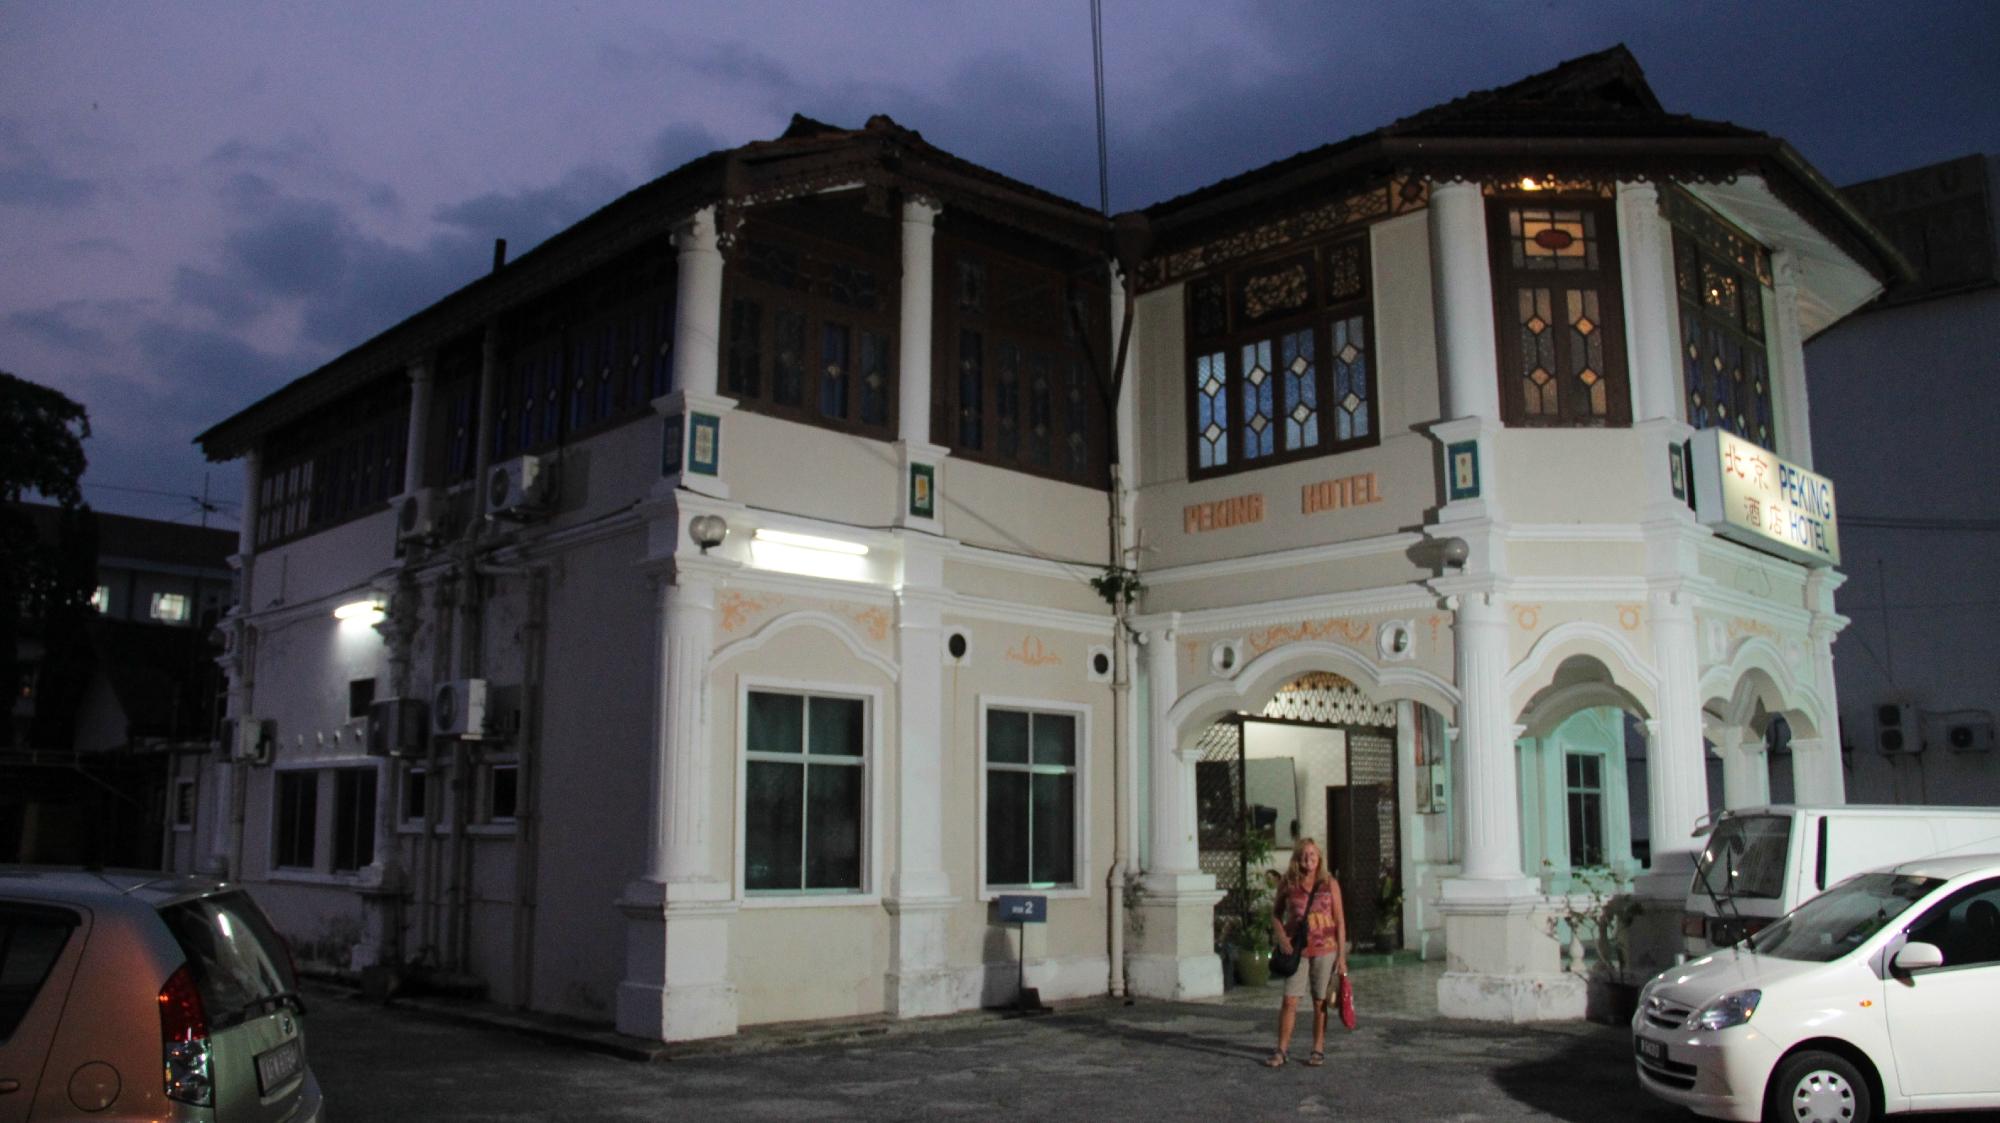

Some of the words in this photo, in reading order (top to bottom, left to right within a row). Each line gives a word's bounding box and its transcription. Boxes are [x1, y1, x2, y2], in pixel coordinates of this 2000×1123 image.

[1725, 443, 1769, 490] 北京
[1184, 492, 1265, 534] PEKING
[1302, 472, 1384, 514] HOTEL
[1779, 463, 1831, 520] PEKING
[1744, 496, 1782, 536] 酒店
[1789, 510, 1830, 553] HOTEL
[1024, 901, 1034, 914] 2
